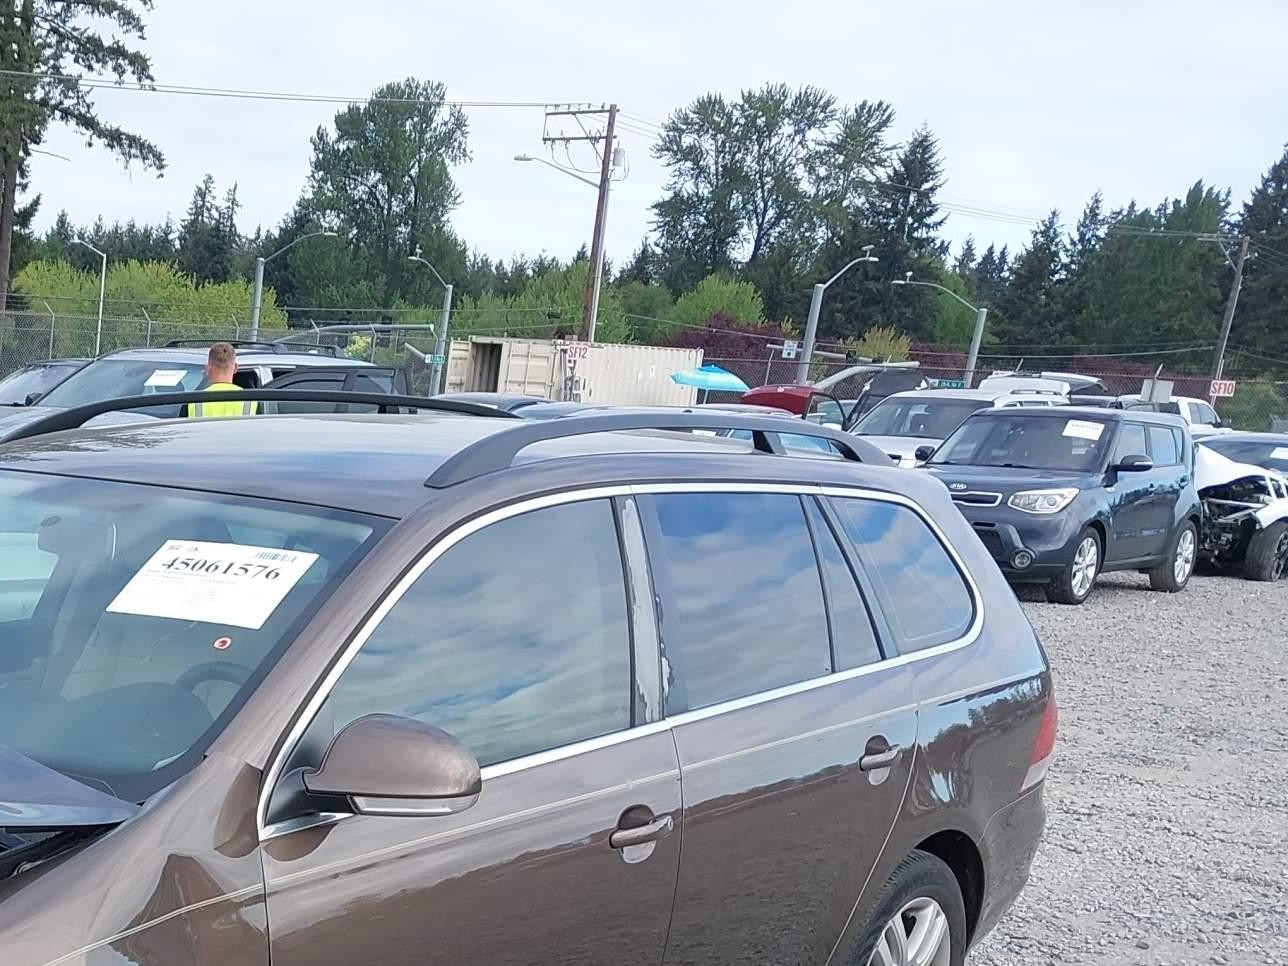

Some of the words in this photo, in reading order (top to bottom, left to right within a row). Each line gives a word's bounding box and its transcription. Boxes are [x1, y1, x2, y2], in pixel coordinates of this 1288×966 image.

[568, 346, 588, 359] SF12
[1211, 381, 1234, 395] SF10
[161, 556, 281, 580] 45061576
